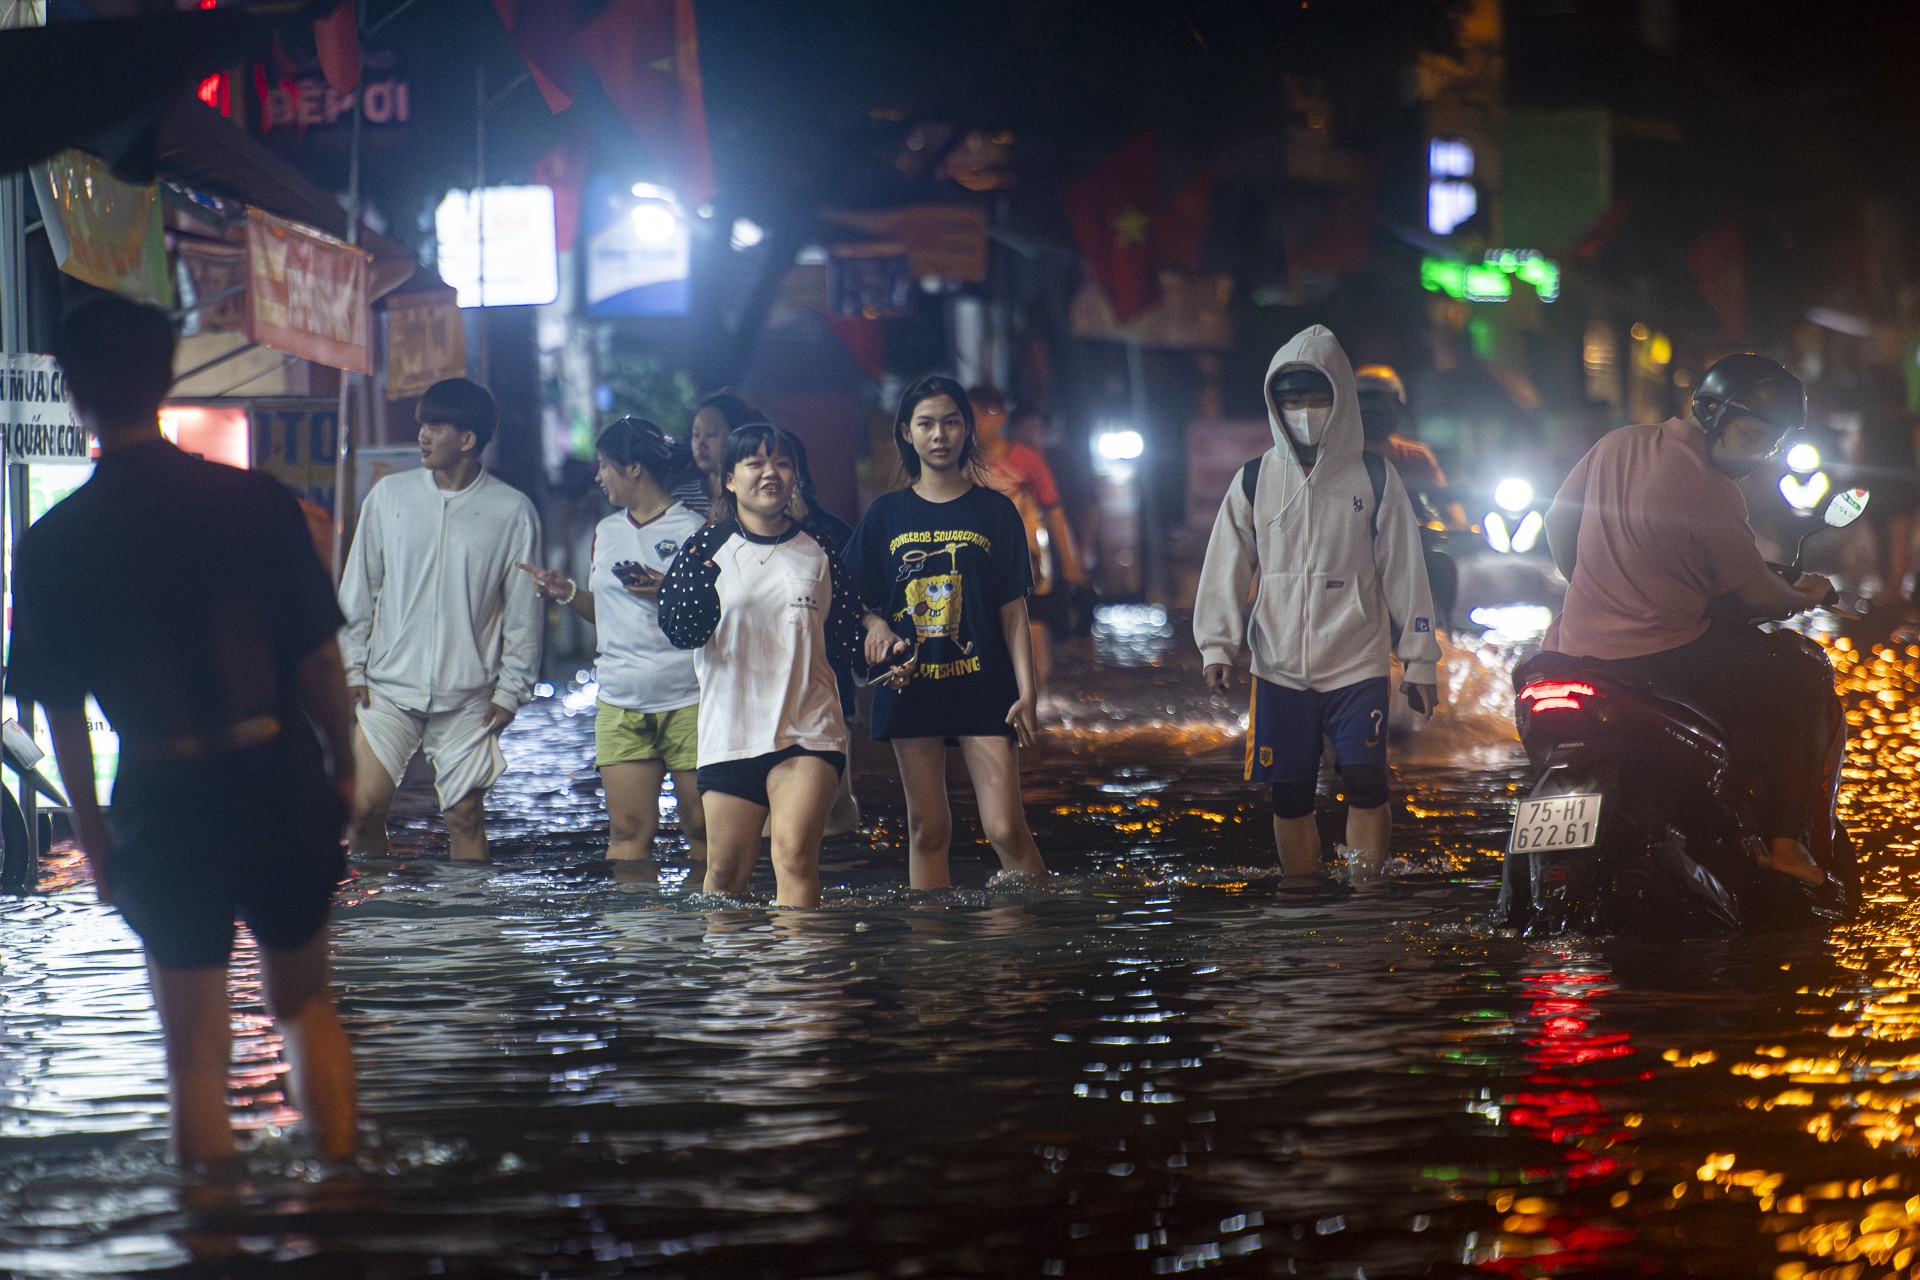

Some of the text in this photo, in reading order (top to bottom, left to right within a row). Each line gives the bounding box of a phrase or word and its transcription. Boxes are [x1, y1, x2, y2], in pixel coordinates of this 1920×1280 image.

[890, 531, 932, 556] SPONGEBOB
[1529, 799, 1586, 824] 75-H1
[1517, 822, 1590, 849] 622.61
